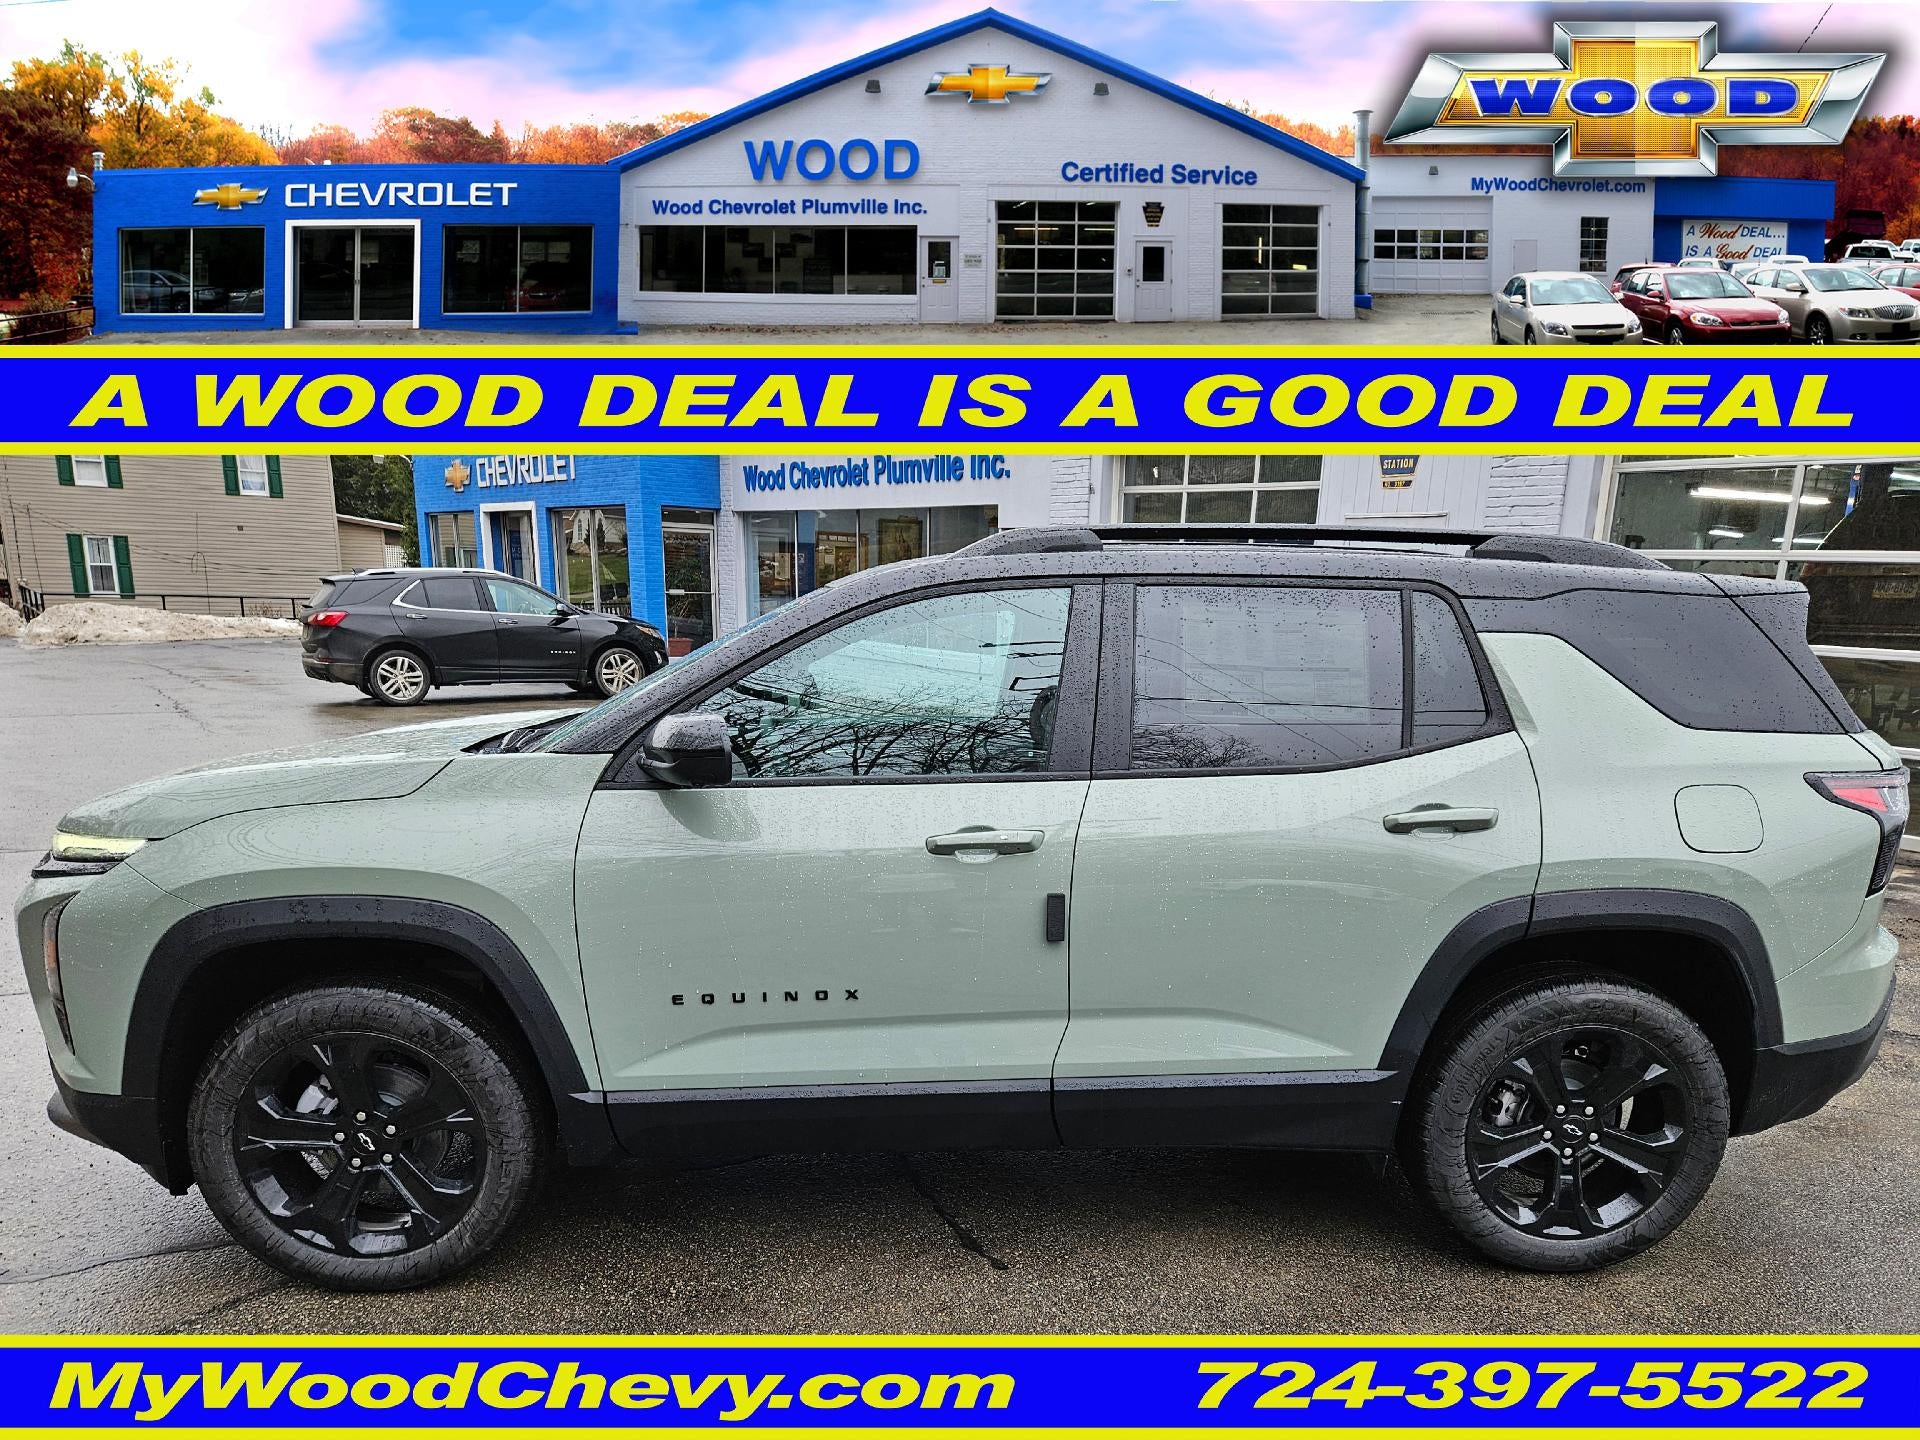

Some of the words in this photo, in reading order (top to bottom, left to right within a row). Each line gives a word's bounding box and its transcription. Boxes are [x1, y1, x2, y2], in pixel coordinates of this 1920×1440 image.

[744, 138, 920, 181] WOOD
[1061, 161, 1164, 184] Certified
[1170, 163, 1258, 186] Service
[1471, 176, 1646, 194] MyWoodChevrolet.com
[284, 182, 518, 207] CHEVROLET
[652, 198, 702, 215] Wood
[708, 198, 796, 215] Chevrolet
[801, 198, 888, 215] Plumville
[893, 198, 928, 215] Inc.
[1686, 225, 1695, 236] A
[1700, 222, 1743, 239] Wood
[1685, 245, 1699, 257] IS
[1703, 246, 1712, 257] A
[1715, 243, 1754, 260] Good
[1383, 458, 1414, 469] STATION
[743, 463, 786, 492] Wood
[788, 458, 870, 490] Chevrolet
[873, 455, 964, 485] Plumville
[970, 455, 1011, 480] Inc.
[671, 989, 860, 1006] EQUINOX
